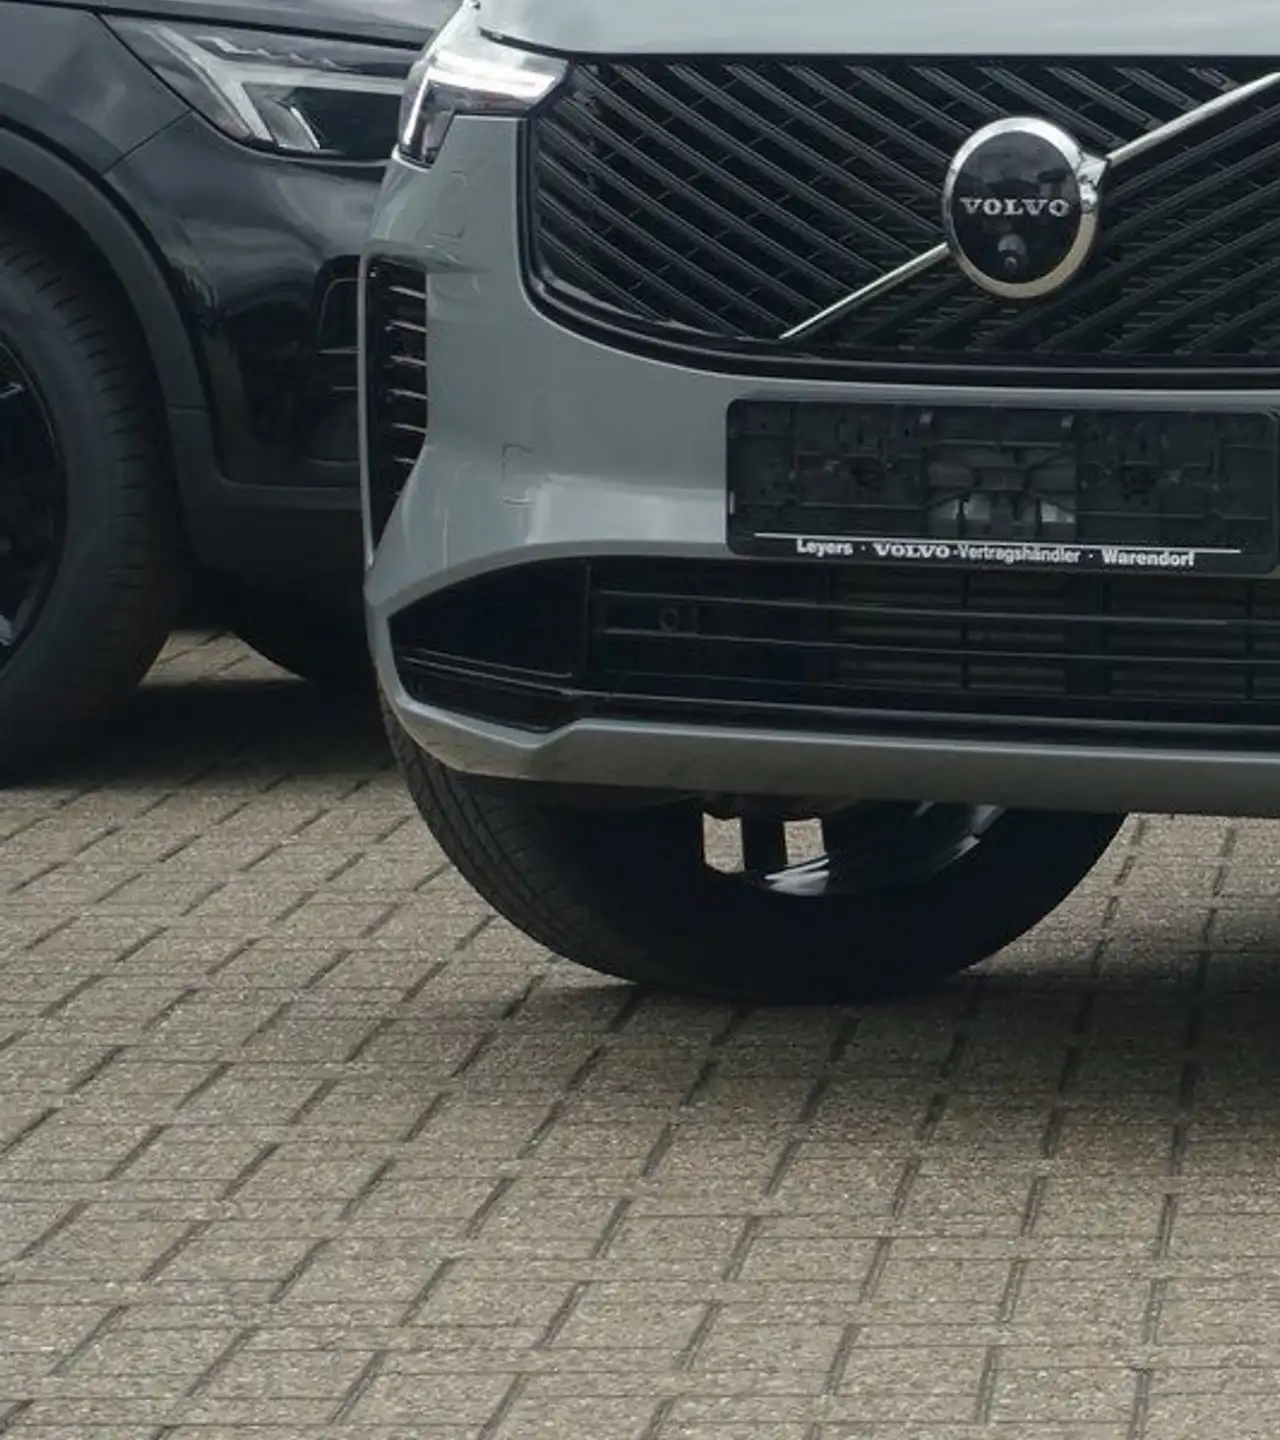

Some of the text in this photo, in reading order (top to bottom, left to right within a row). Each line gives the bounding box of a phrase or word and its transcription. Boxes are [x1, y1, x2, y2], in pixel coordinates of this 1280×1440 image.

[960, 196, 1070, 217] VOLVO
[796, 537, 854, 557] Leyers
[872, 542, 950, 559] VOLVO
[1101, 548, 1196, 567] Warendorf
